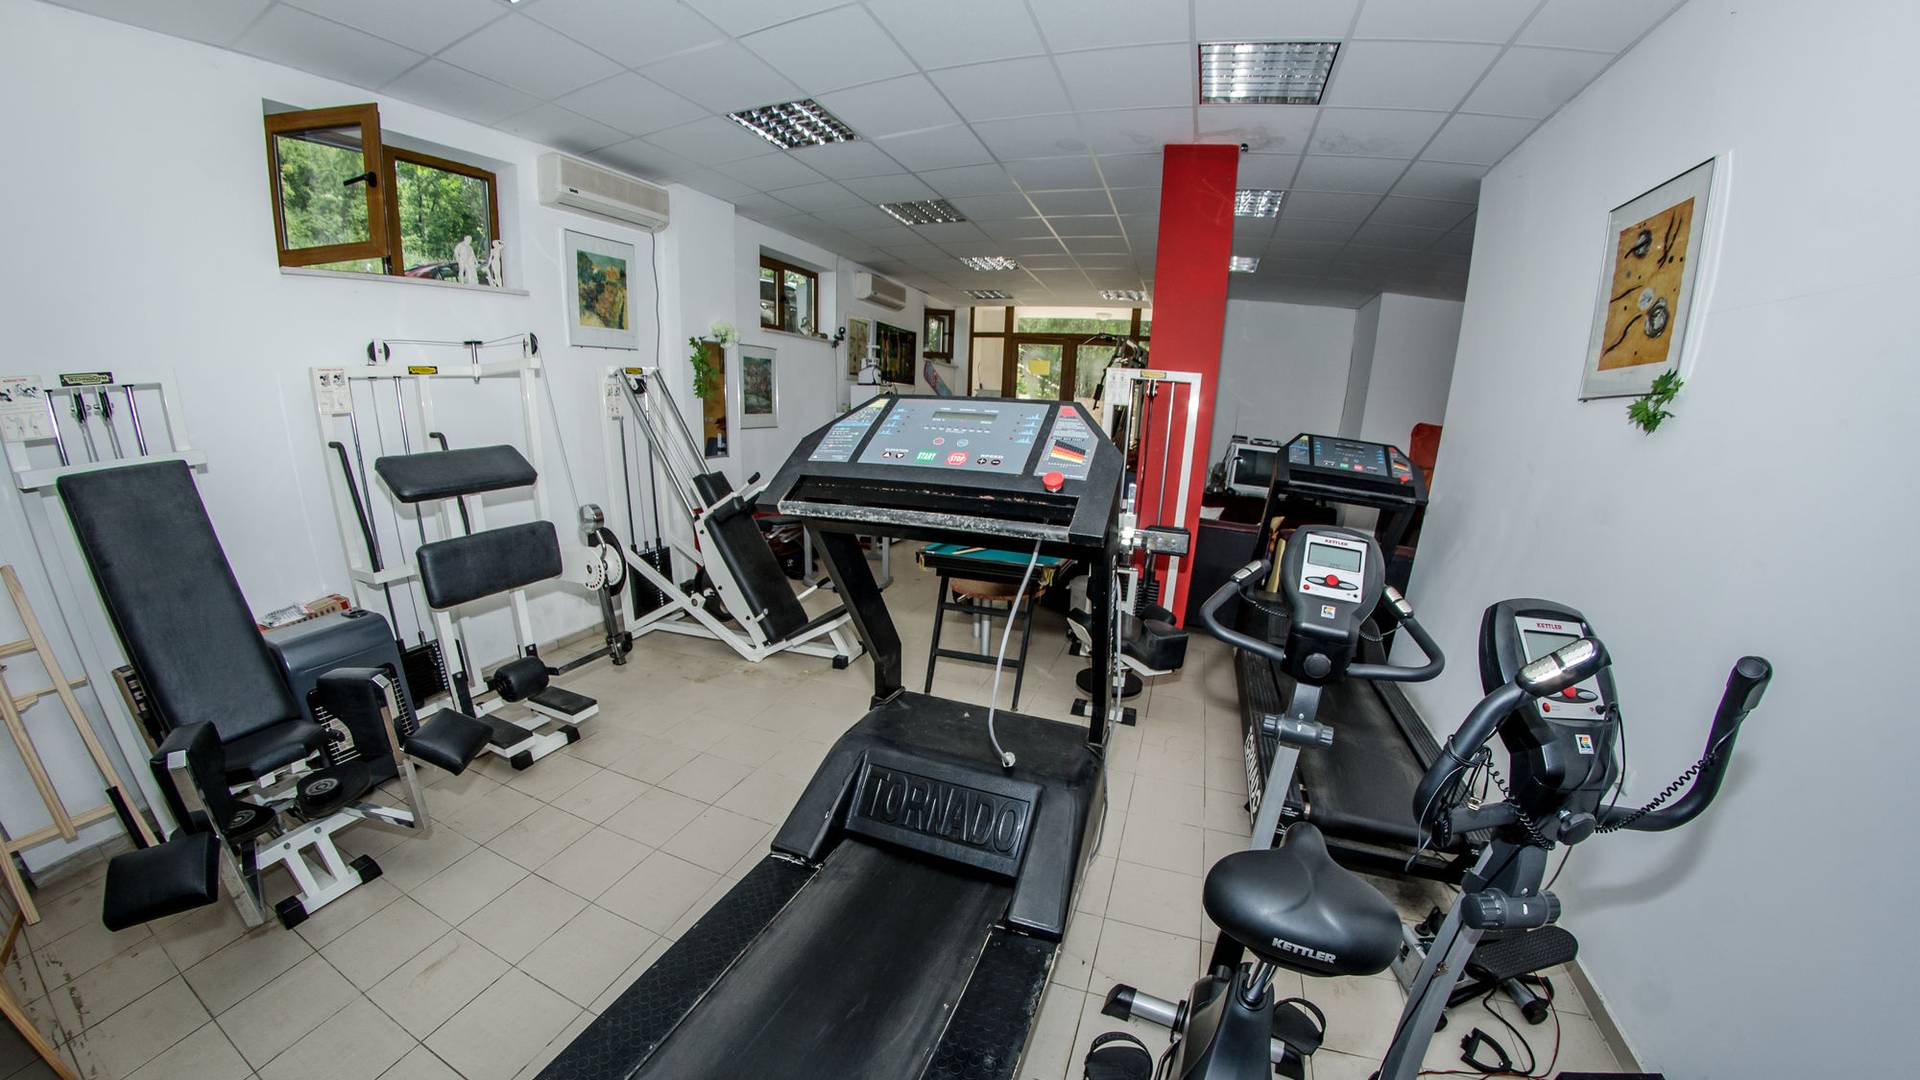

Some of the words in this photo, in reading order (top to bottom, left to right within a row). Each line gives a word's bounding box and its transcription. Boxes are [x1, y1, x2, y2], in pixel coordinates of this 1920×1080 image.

[917, 451, 936, 460] START
[1324, 539, 1349, 547] KETTLER
[1536, 622, 1563, 631] KETTLER
[867, 770, 1024, 854] TORNADO
[1271, 937, 1337, 965] KETTLER
